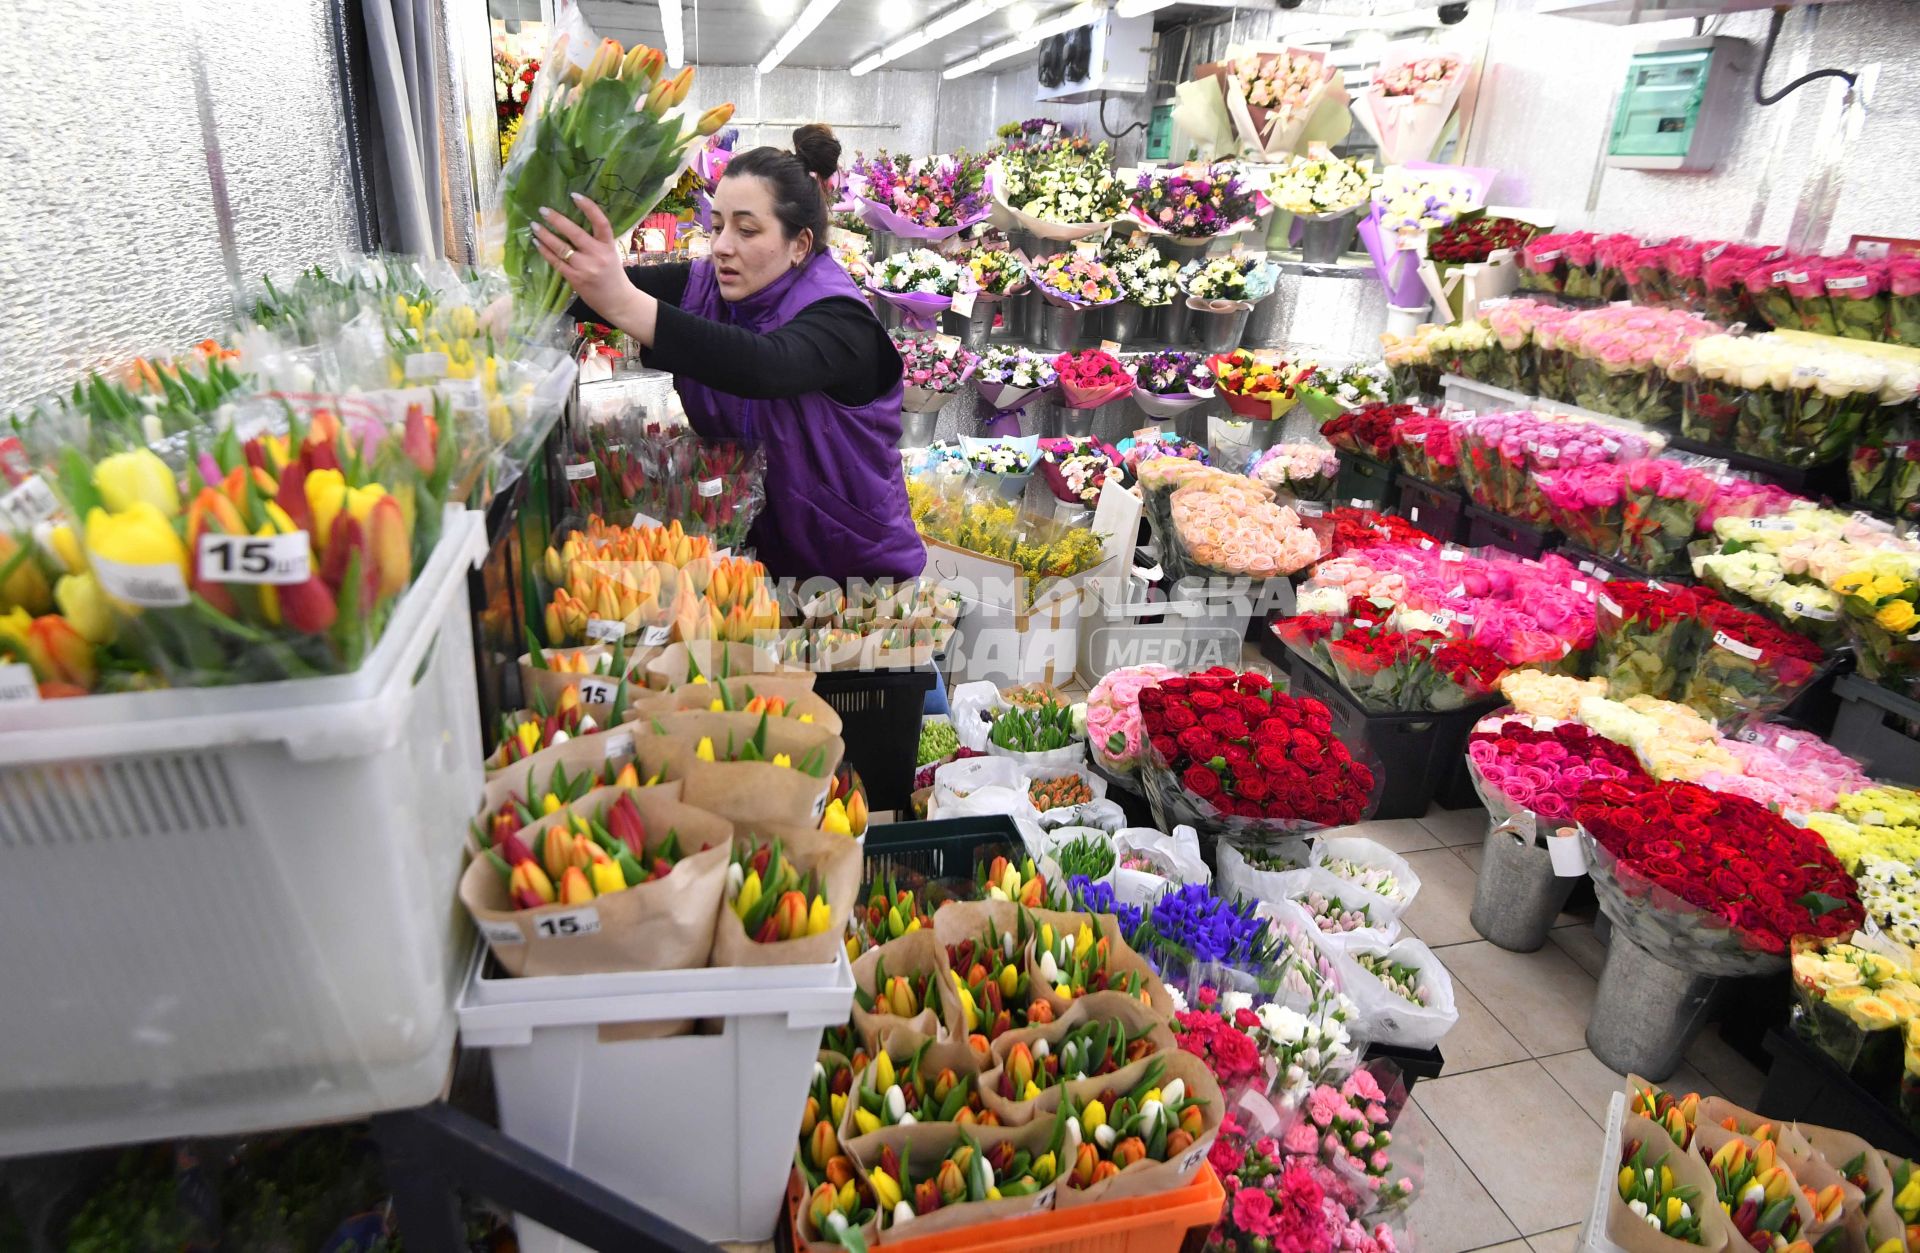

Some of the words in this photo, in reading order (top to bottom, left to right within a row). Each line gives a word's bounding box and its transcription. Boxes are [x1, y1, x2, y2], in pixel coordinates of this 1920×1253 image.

[1750, 520, 1762, 528] 11
[209, 542, 273, 573] 15
[1795, 601, 1804, 612] 9
[1432, 615, 1444, 625] 10
[1716, 633, 1727, 645] 11
[581, 685, 607, 705] 15
[1747, 732, 1758, 741] 9
[541, 916, 580, 936] 15
